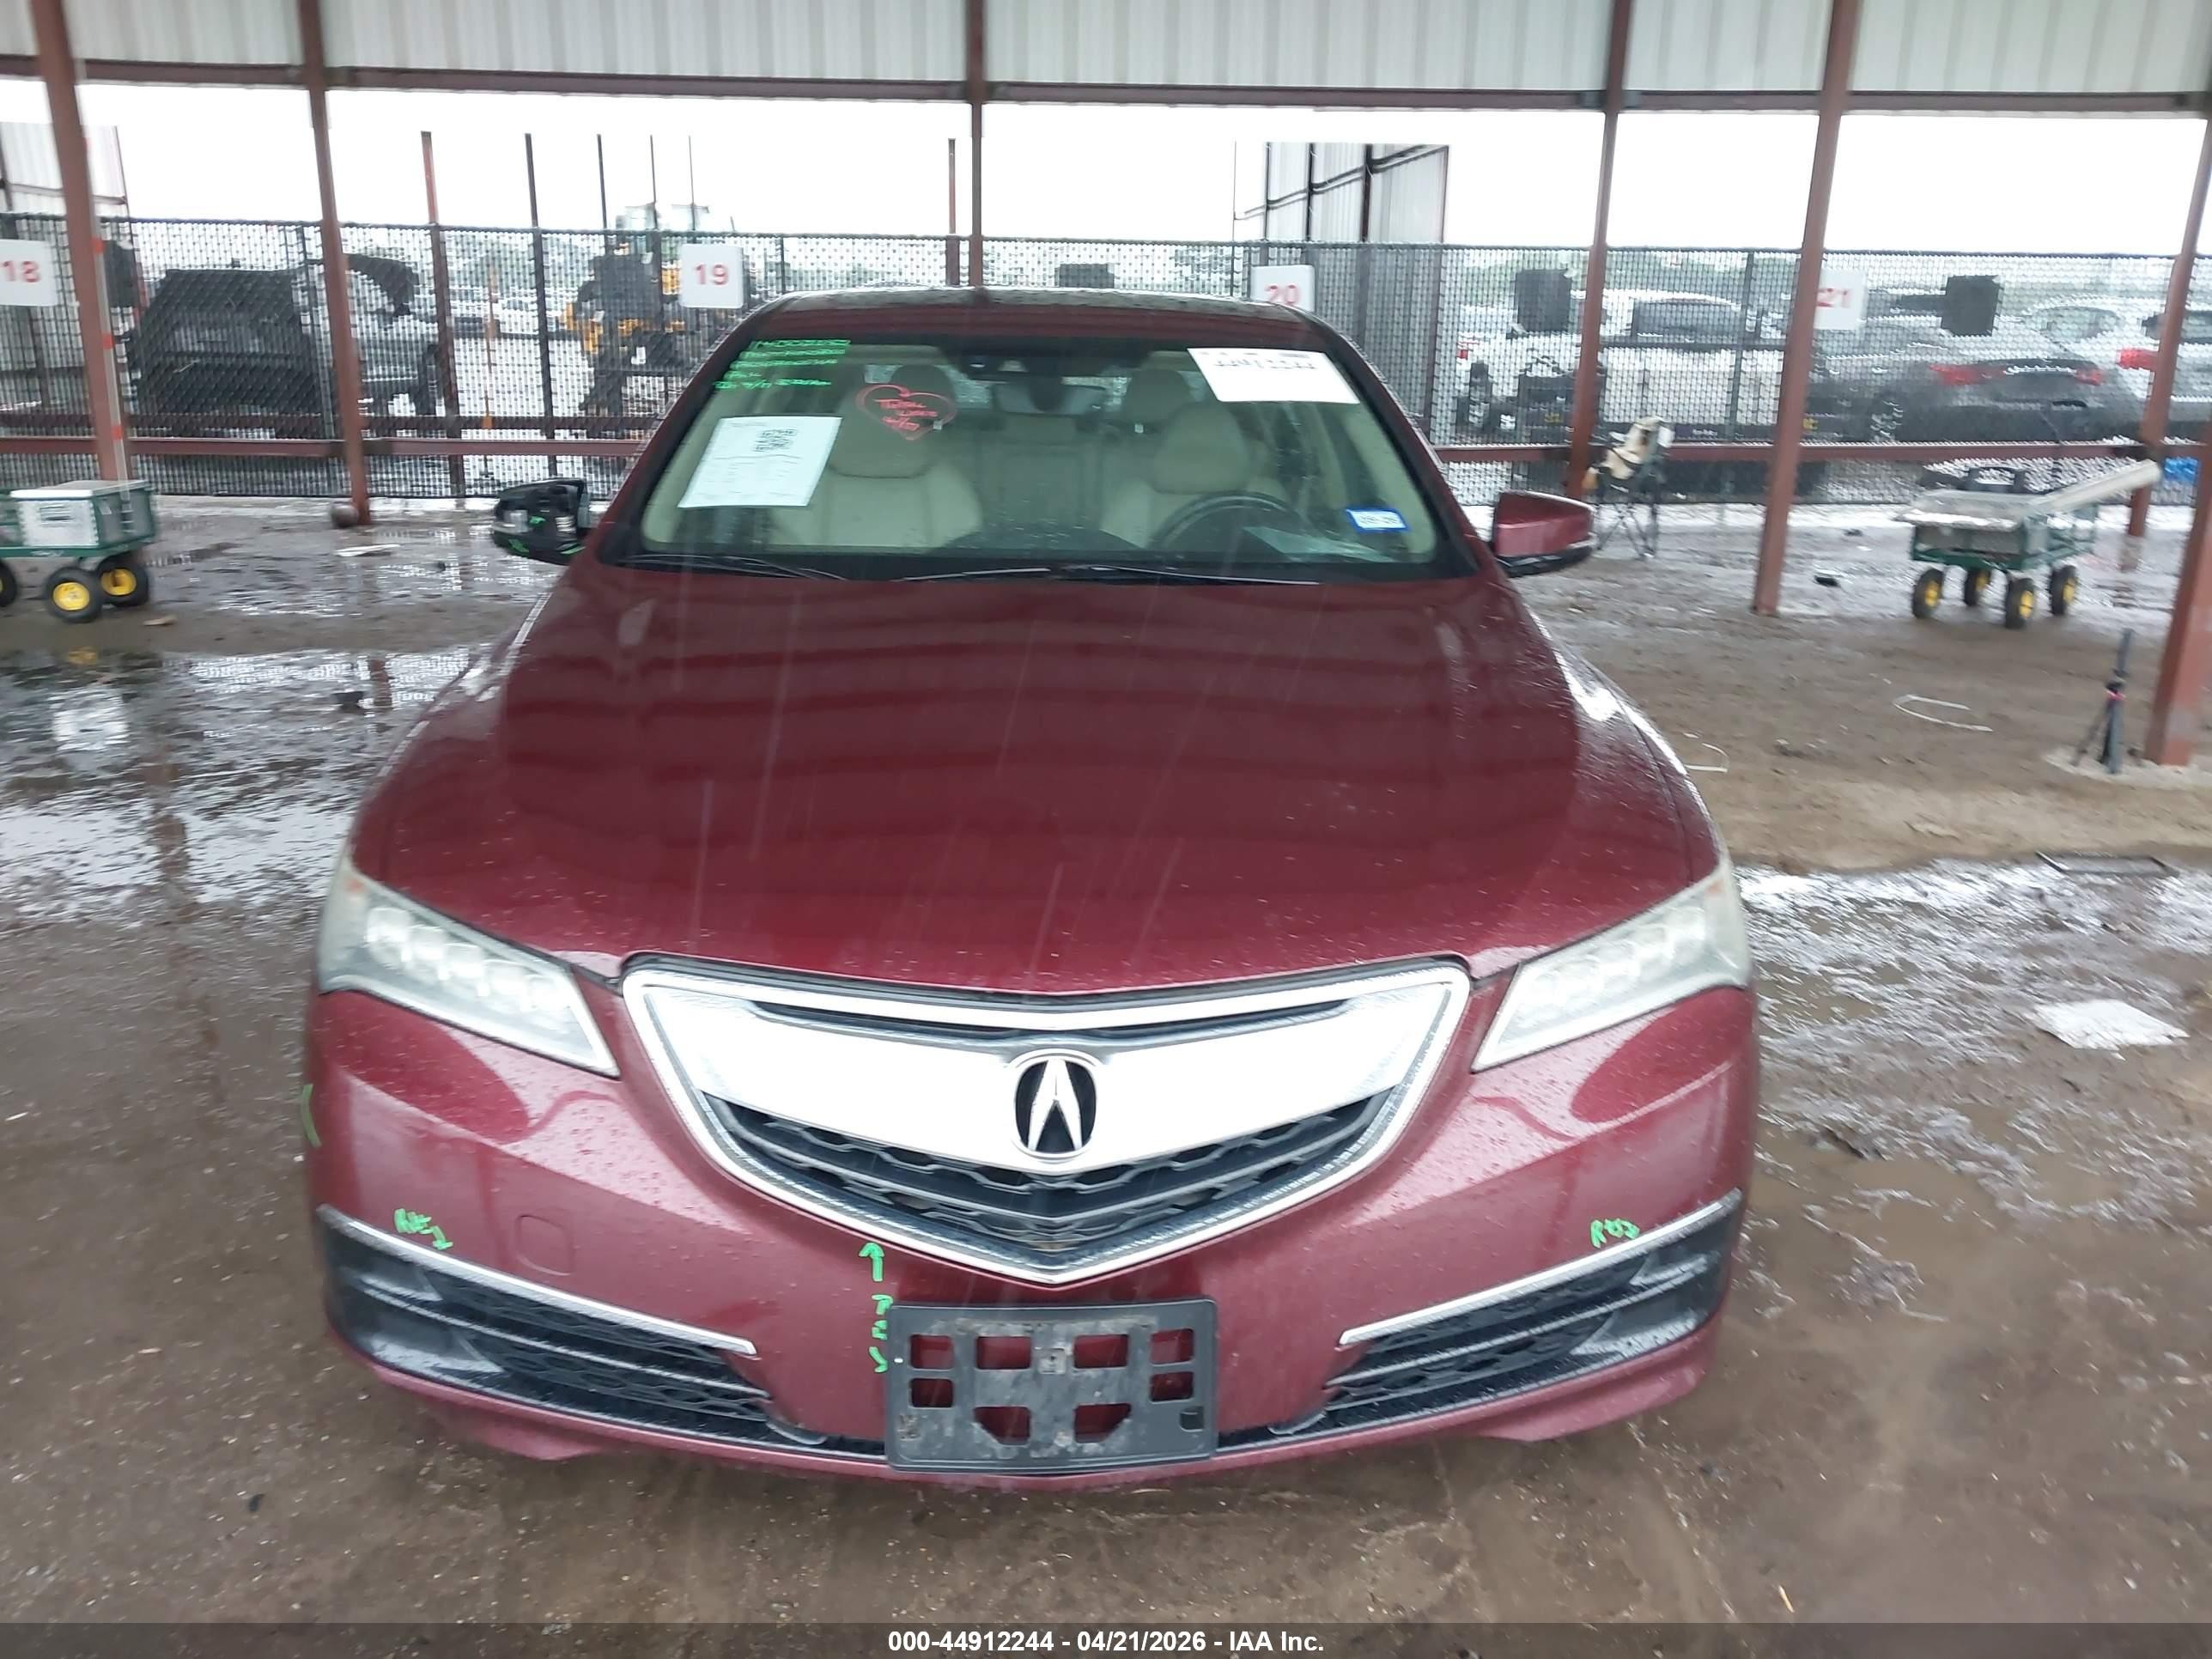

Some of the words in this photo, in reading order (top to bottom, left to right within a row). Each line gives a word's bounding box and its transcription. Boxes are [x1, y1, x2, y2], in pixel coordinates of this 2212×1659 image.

[1, 260, 41, 283] 18
[695, 264, 729, 285] 19
[1817, 288, 1850, 308] 21
